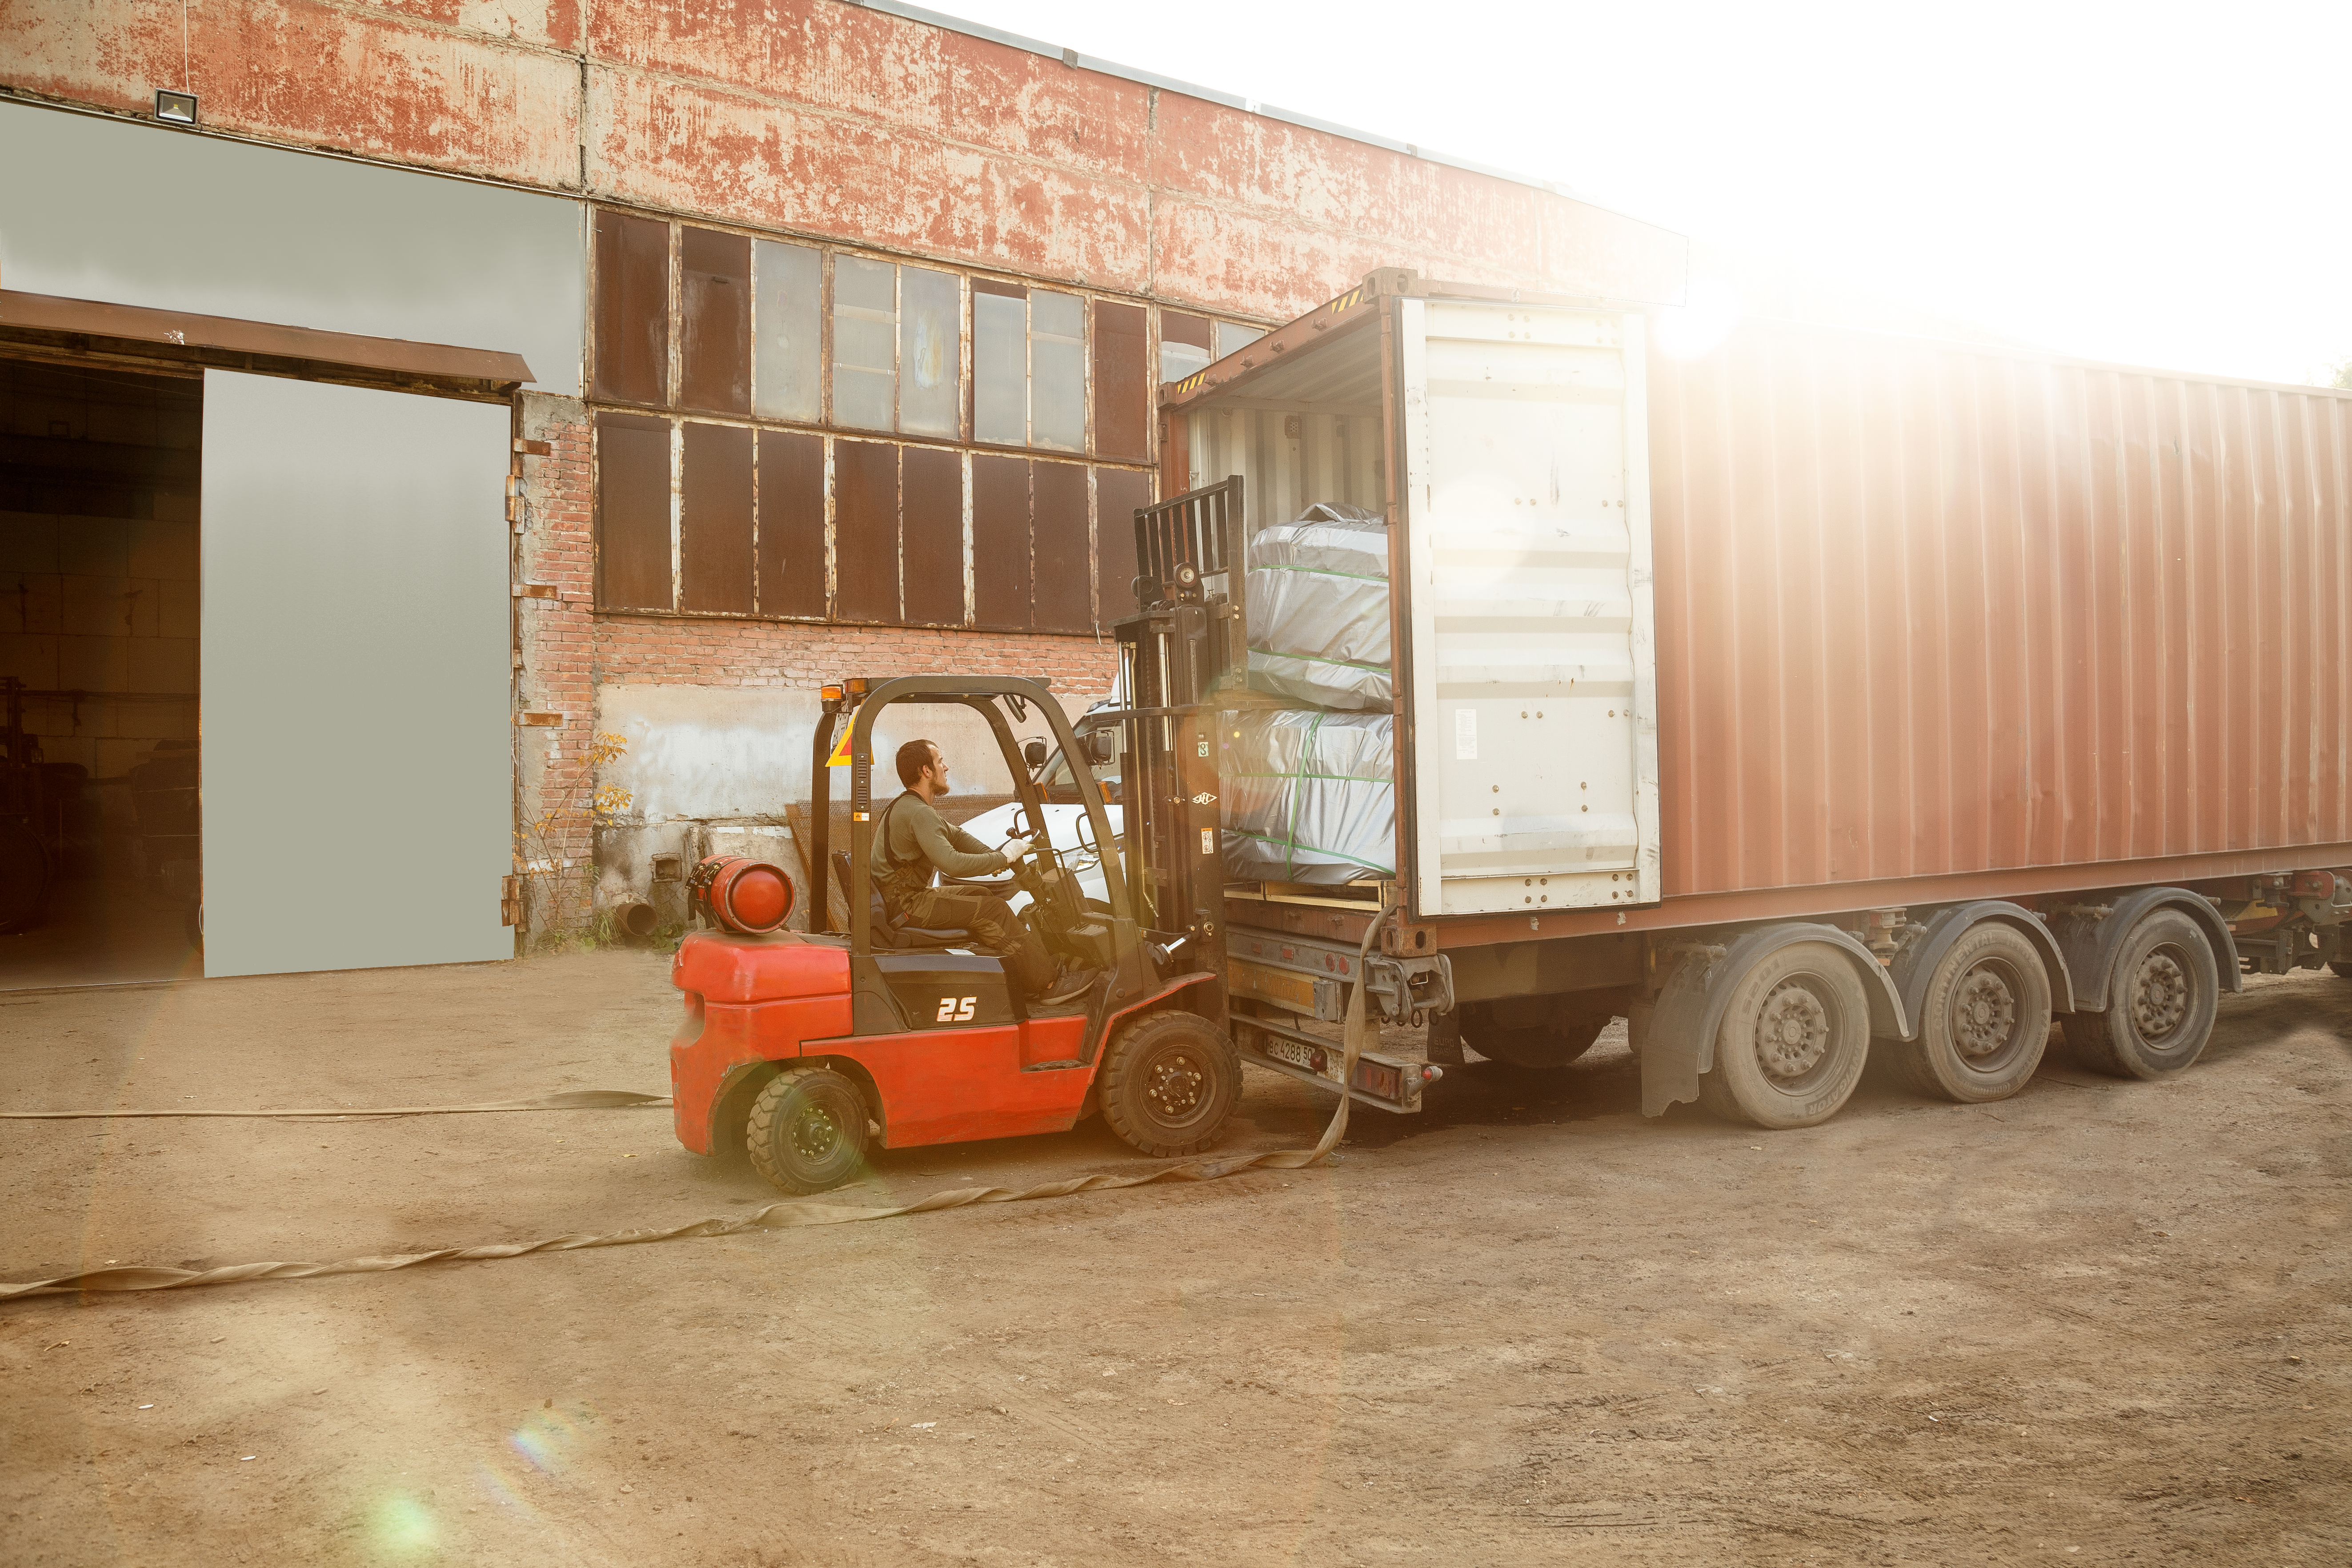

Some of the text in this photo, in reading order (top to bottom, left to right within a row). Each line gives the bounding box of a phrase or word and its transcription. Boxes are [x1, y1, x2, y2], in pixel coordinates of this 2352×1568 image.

[937, 997, 977, 1022] 25
[1280, 1040, 1301, 1063] 4288
[1303, 1047, 1312, 1060] 50
[1434, 1036, 1454, 1047] EURO
